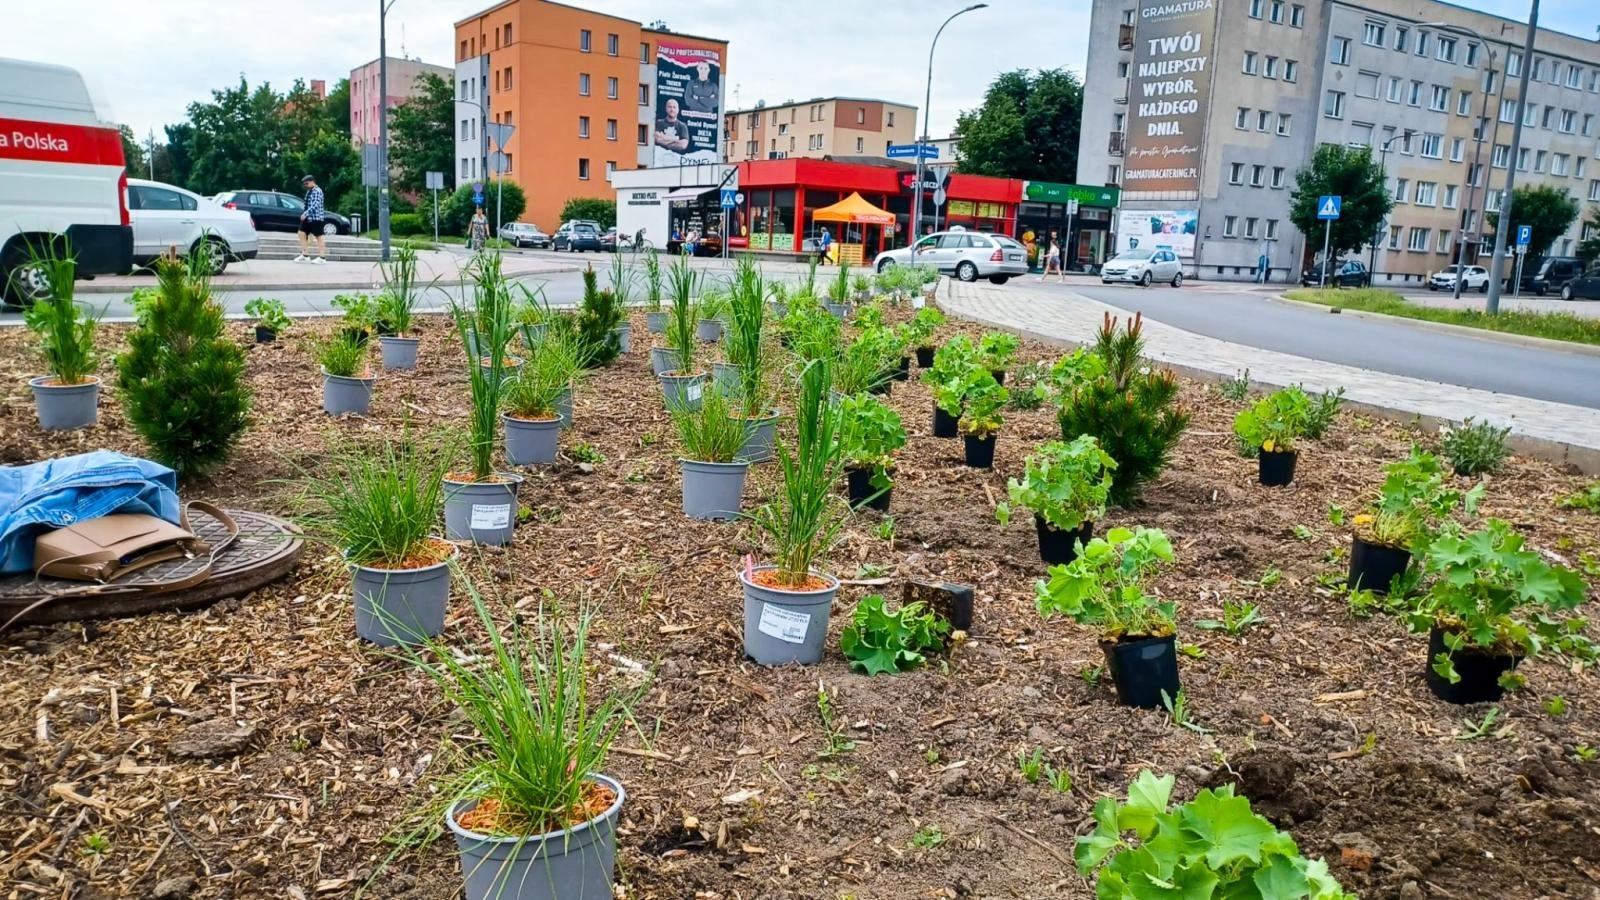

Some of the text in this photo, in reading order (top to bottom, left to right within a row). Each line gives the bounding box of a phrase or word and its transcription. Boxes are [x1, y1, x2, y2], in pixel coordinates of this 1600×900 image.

[1142, 0, 1212, 18] GRAMATURA
[1148, 31, 1202, 56] TWÓJ
[1138, 57, 1207, 77] NAJLEPSZY
[1142, 76, 1198, 97] WYBÓR,
[1138, 99, 1198, 117] KAŻDEGO
[1147, 120, 1184, 137] DNIA.
[12, 131, 69, 152] Polska
[1125, 167, 1198, 180] GRAMATURACATERING.PL
[1521, 228, 1529, 241] P
